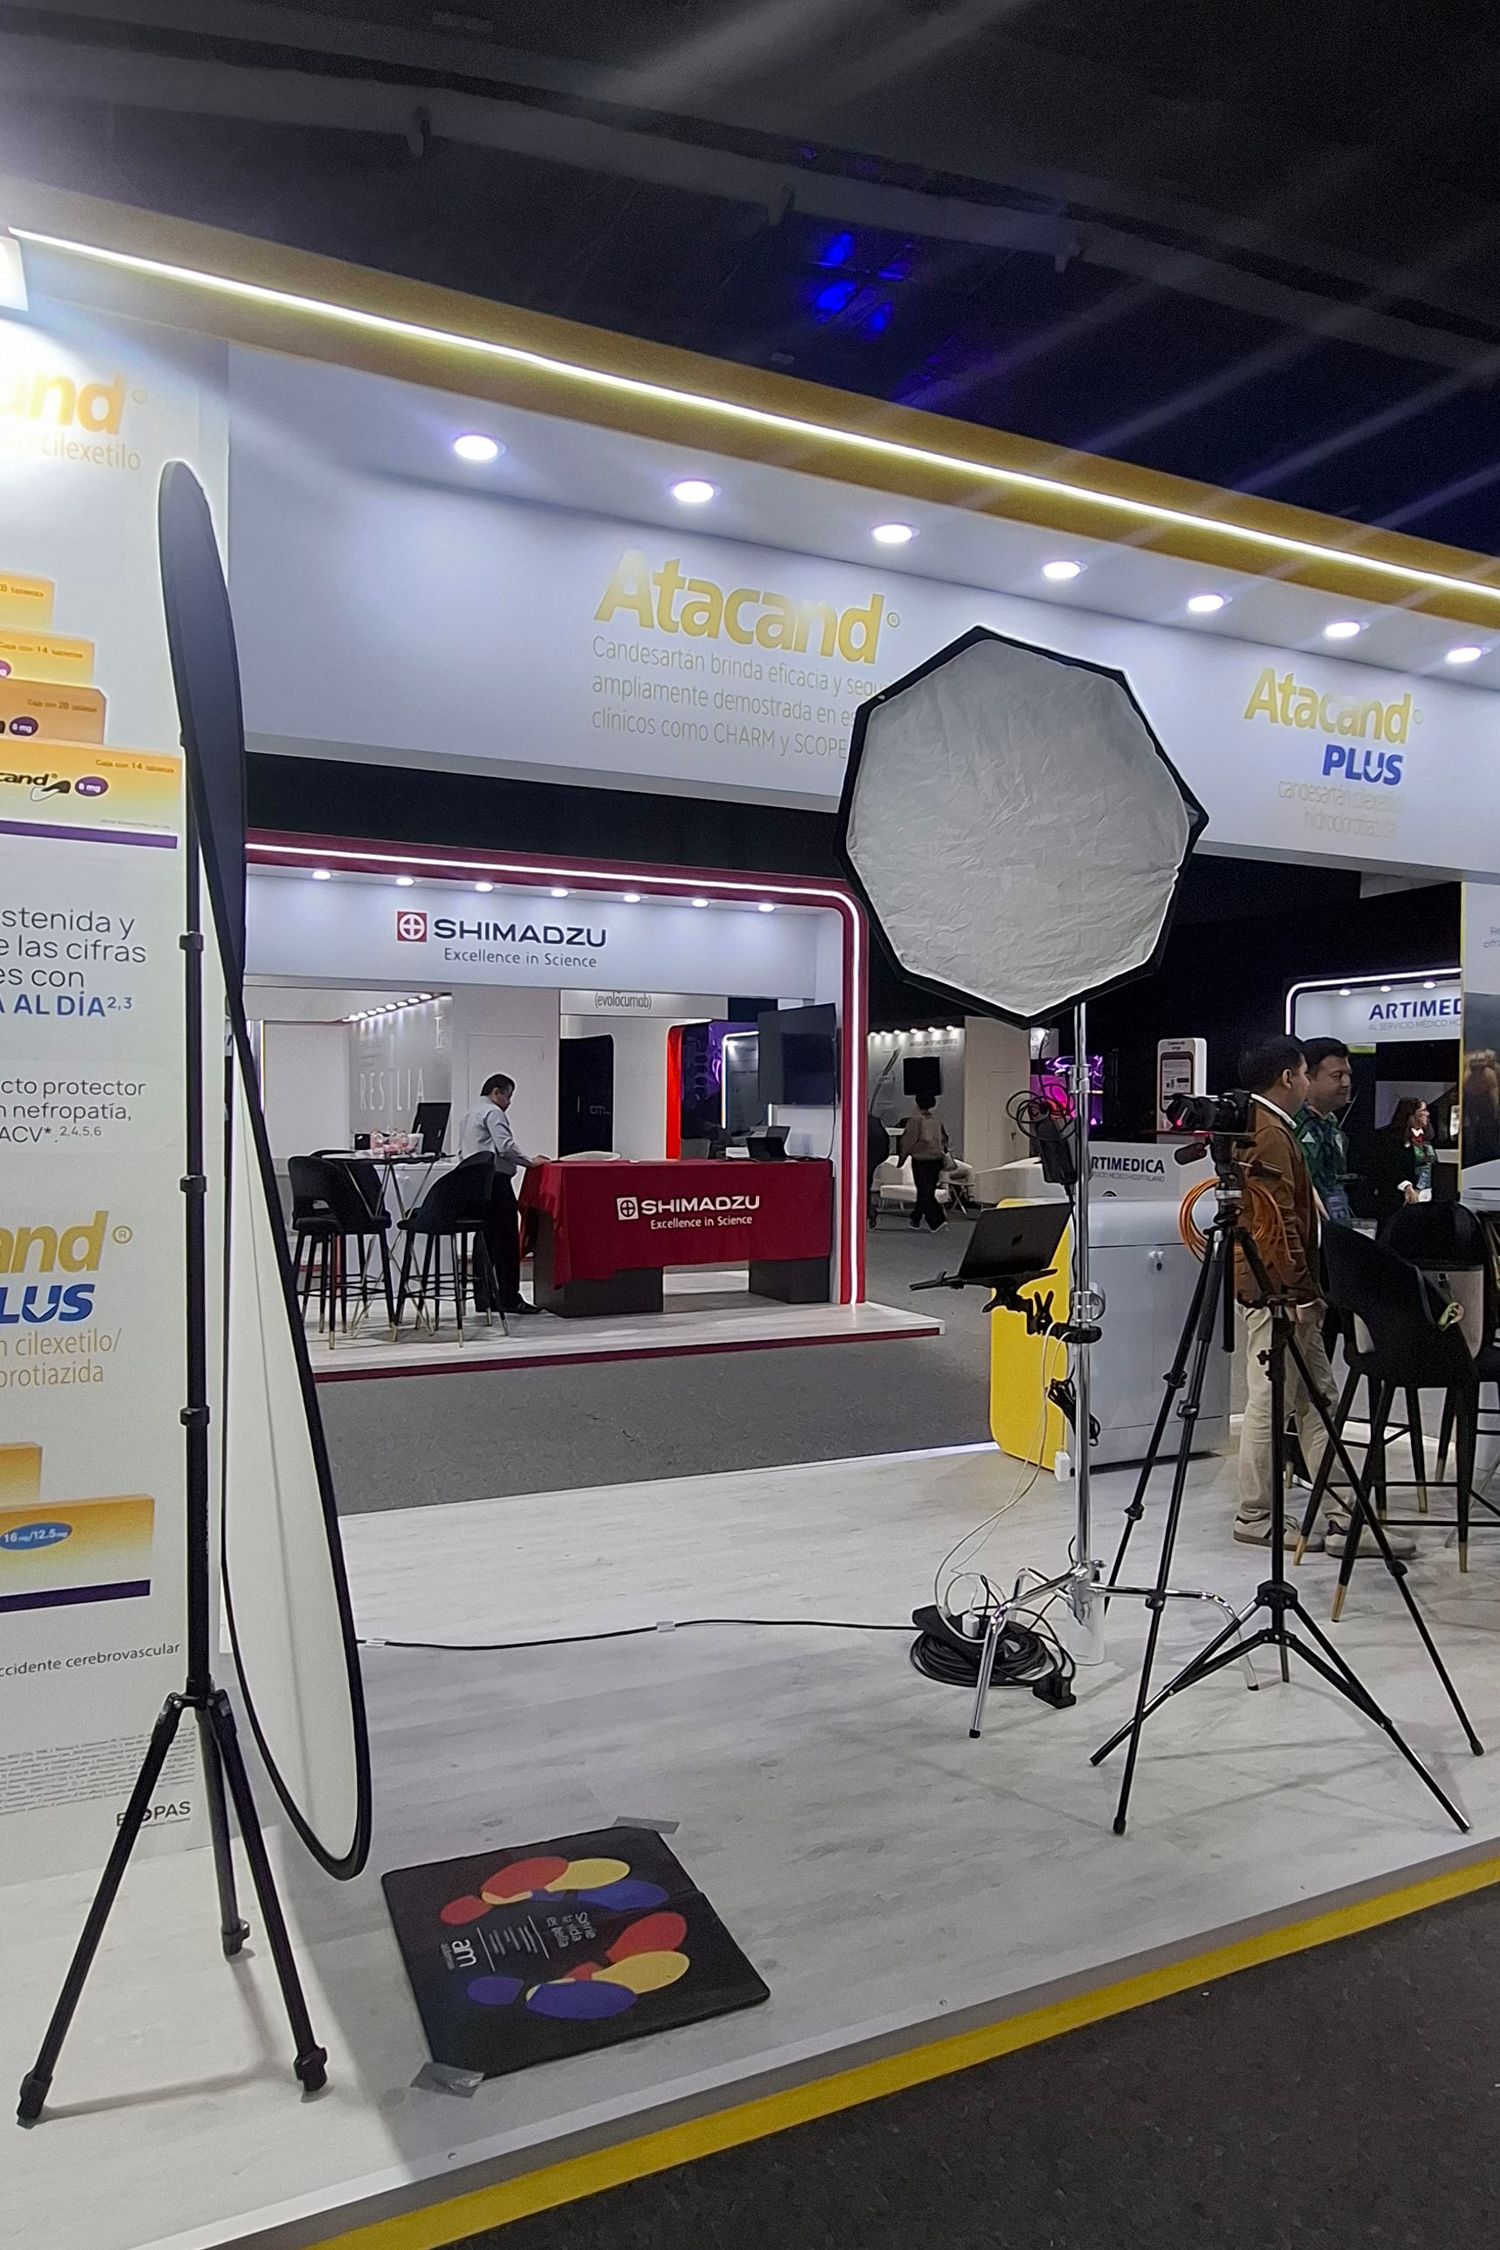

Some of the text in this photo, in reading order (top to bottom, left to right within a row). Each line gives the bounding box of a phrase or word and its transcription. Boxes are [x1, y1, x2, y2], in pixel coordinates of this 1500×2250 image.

[592, 635, 888, 697] Candesartán brinda eficacia y segu
[592, 675, 708, 707] ampliamente
[714, 688, 812, 721] demostrada
[817, 706, 836, 724] en
[592, 706, 847, 760] clínicos como CHARM y SCOPE
[1322, 744, 1404, 786] PLUS
[119, 917, 135, 941] y
[433, 918, 607, 948] SHIMADZU
[18, 934, 59, 959] las
[66, 938, 147, 963] cifras
[444, 948, 598, 968] Excellence in Science
[31, 969, 85, 988] con
[14, 994, 51, 1015] AL
[594, 992, 653, 1010] (evolocumab)
[43, 1079, 147, 1099] protector
[13, 1102, 132, 1123] nefropatía,
[1091, 1156, 1165, 1174] RTIMEDICA
[641, 1195, 760, 1215] SHIMADZU
[650, 1216, 753, 1230] Excellence in Science
[16, 1327, 122, 1356] cilexetilo/
[66, 1642, 181, 1668] cerebrovascular
[116, 1800, 191, 1827] BOPAS
